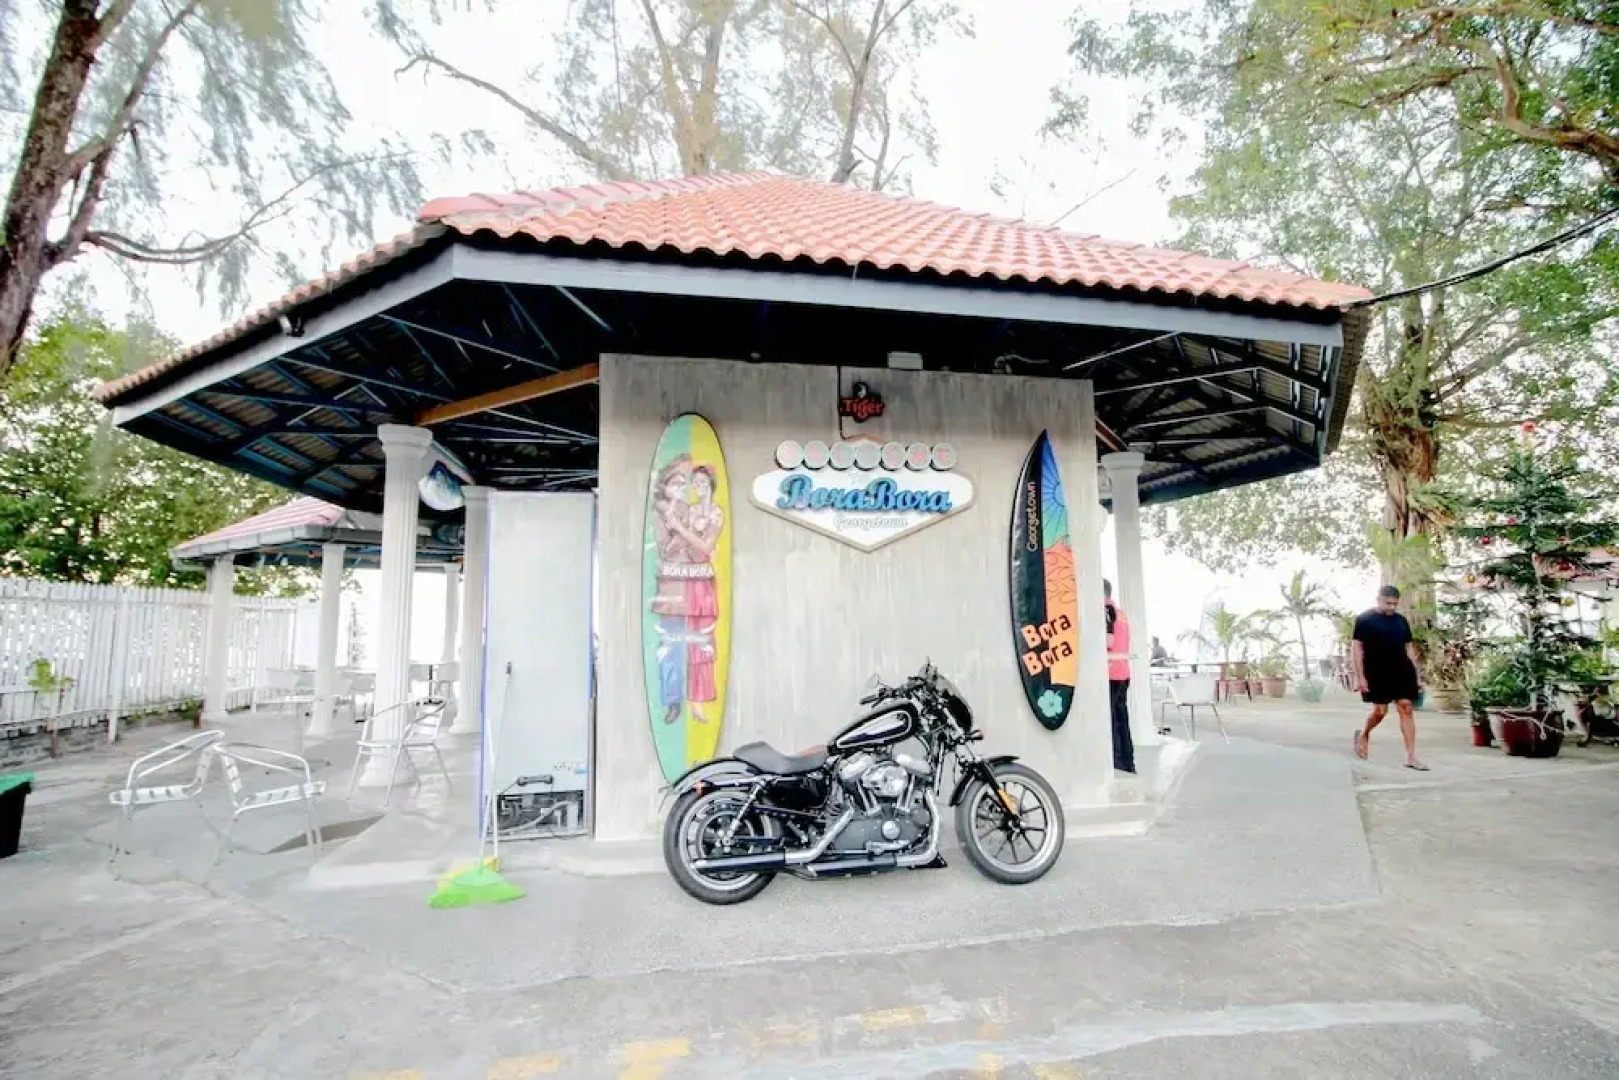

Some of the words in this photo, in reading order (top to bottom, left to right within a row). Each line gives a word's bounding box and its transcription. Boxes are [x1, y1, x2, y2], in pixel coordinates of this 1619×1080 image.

[843, 399, 883, 418] Tiger
[1026, 481, 1038, 551] Georgetown
[662, 563, 687, 578] BORA
[1021, 614, 1072, 649] Bora
[1023, 640, 1073, 676] Bora
